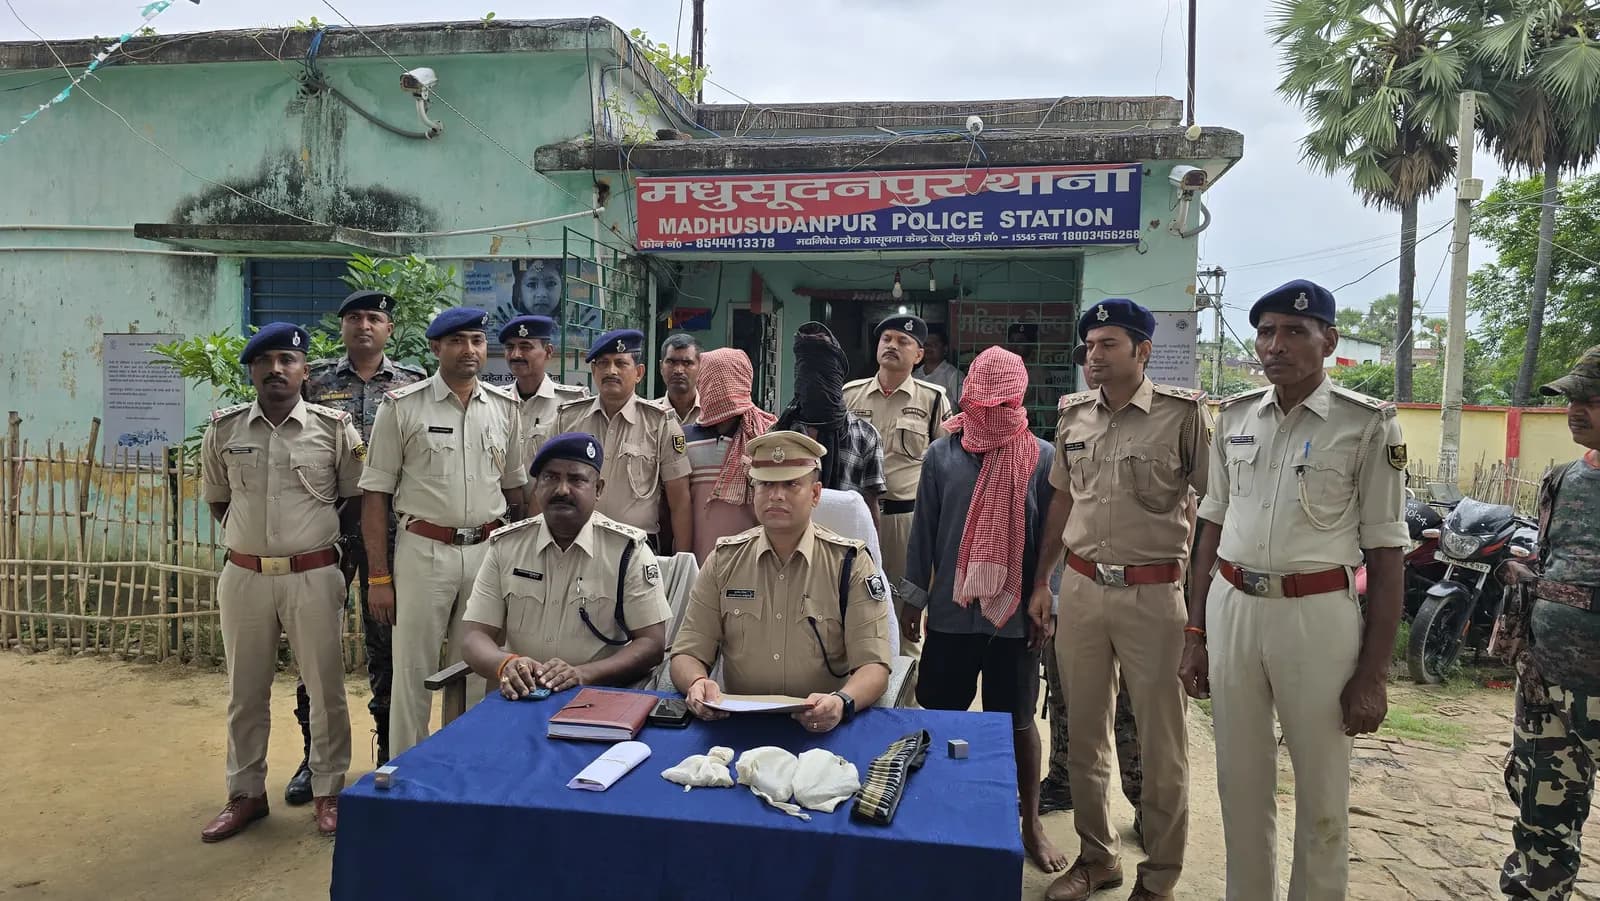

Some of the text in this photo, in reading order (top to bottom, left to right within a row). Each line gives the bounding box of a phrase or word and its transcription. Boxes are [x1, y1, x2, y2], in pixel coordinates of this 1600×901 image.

[638, 168, 1137, 211] मधुसूदनपुर थाना
[659, 207, 1113, 234] MADHUSUDANPUR POLICE STATION
[640, 238, 664, 250] फोन
[695, 238, 775, 249] 8544413378
[795, 235, 837, 246] मद्यनिषेध
[839, 235, 861, 245] लोक
[863, 234, 903, 247] आसूचना
[905, 233, 928, 243] केन्द्र
[930, 234, 944, 243] का
[946, 231, 966, 242] टोल
[967, 231, 981, 243] फ्री
[1011, 232, 1037, 241] 15545
[1038, 231, 1059, 241] तथा
